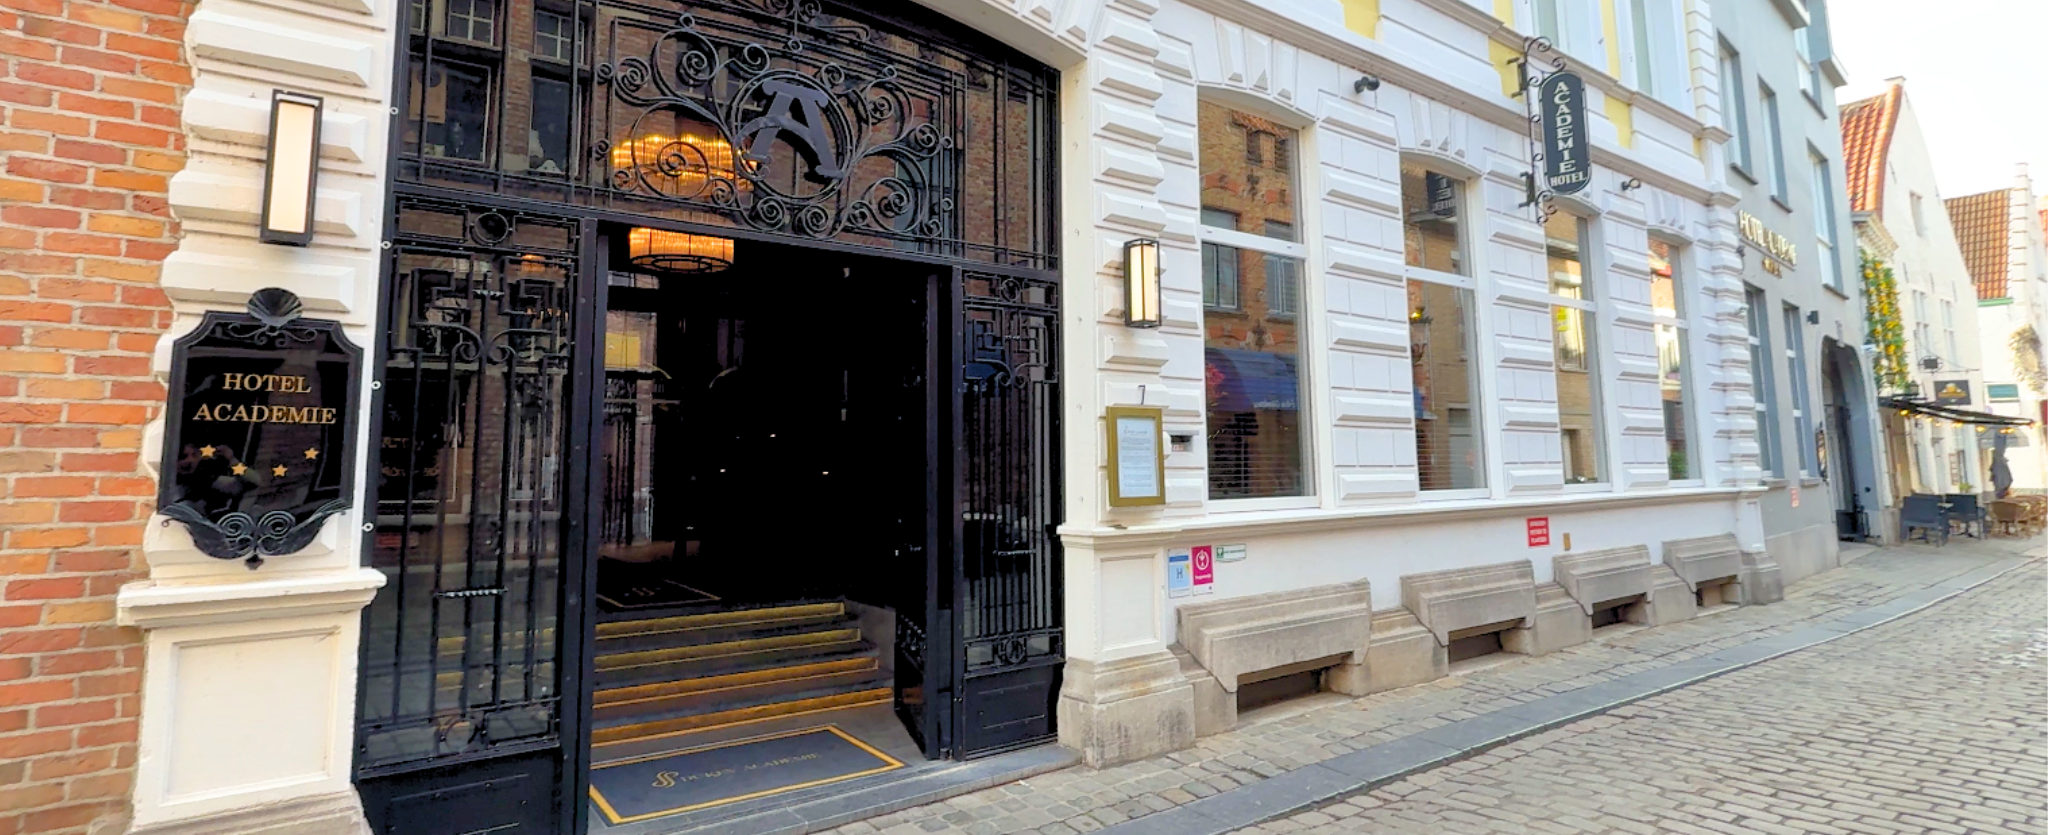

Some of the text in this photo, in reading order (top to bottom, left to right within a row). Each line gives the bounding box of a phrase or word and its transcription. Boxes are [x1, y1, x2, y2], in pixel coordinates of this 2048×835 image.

[735, 80, 844, 180] A
[1553, 81, 1576, 173] ACADEMIE
[1550, 171, 1586, 187] HOTEL
[1739, 209, 1767, 246] HOTEL
[223, 373, 312, 394] HOTEL
[1138, 385, 1146, 405] 7
[192, 403, 337, 424] ACADEMIE
